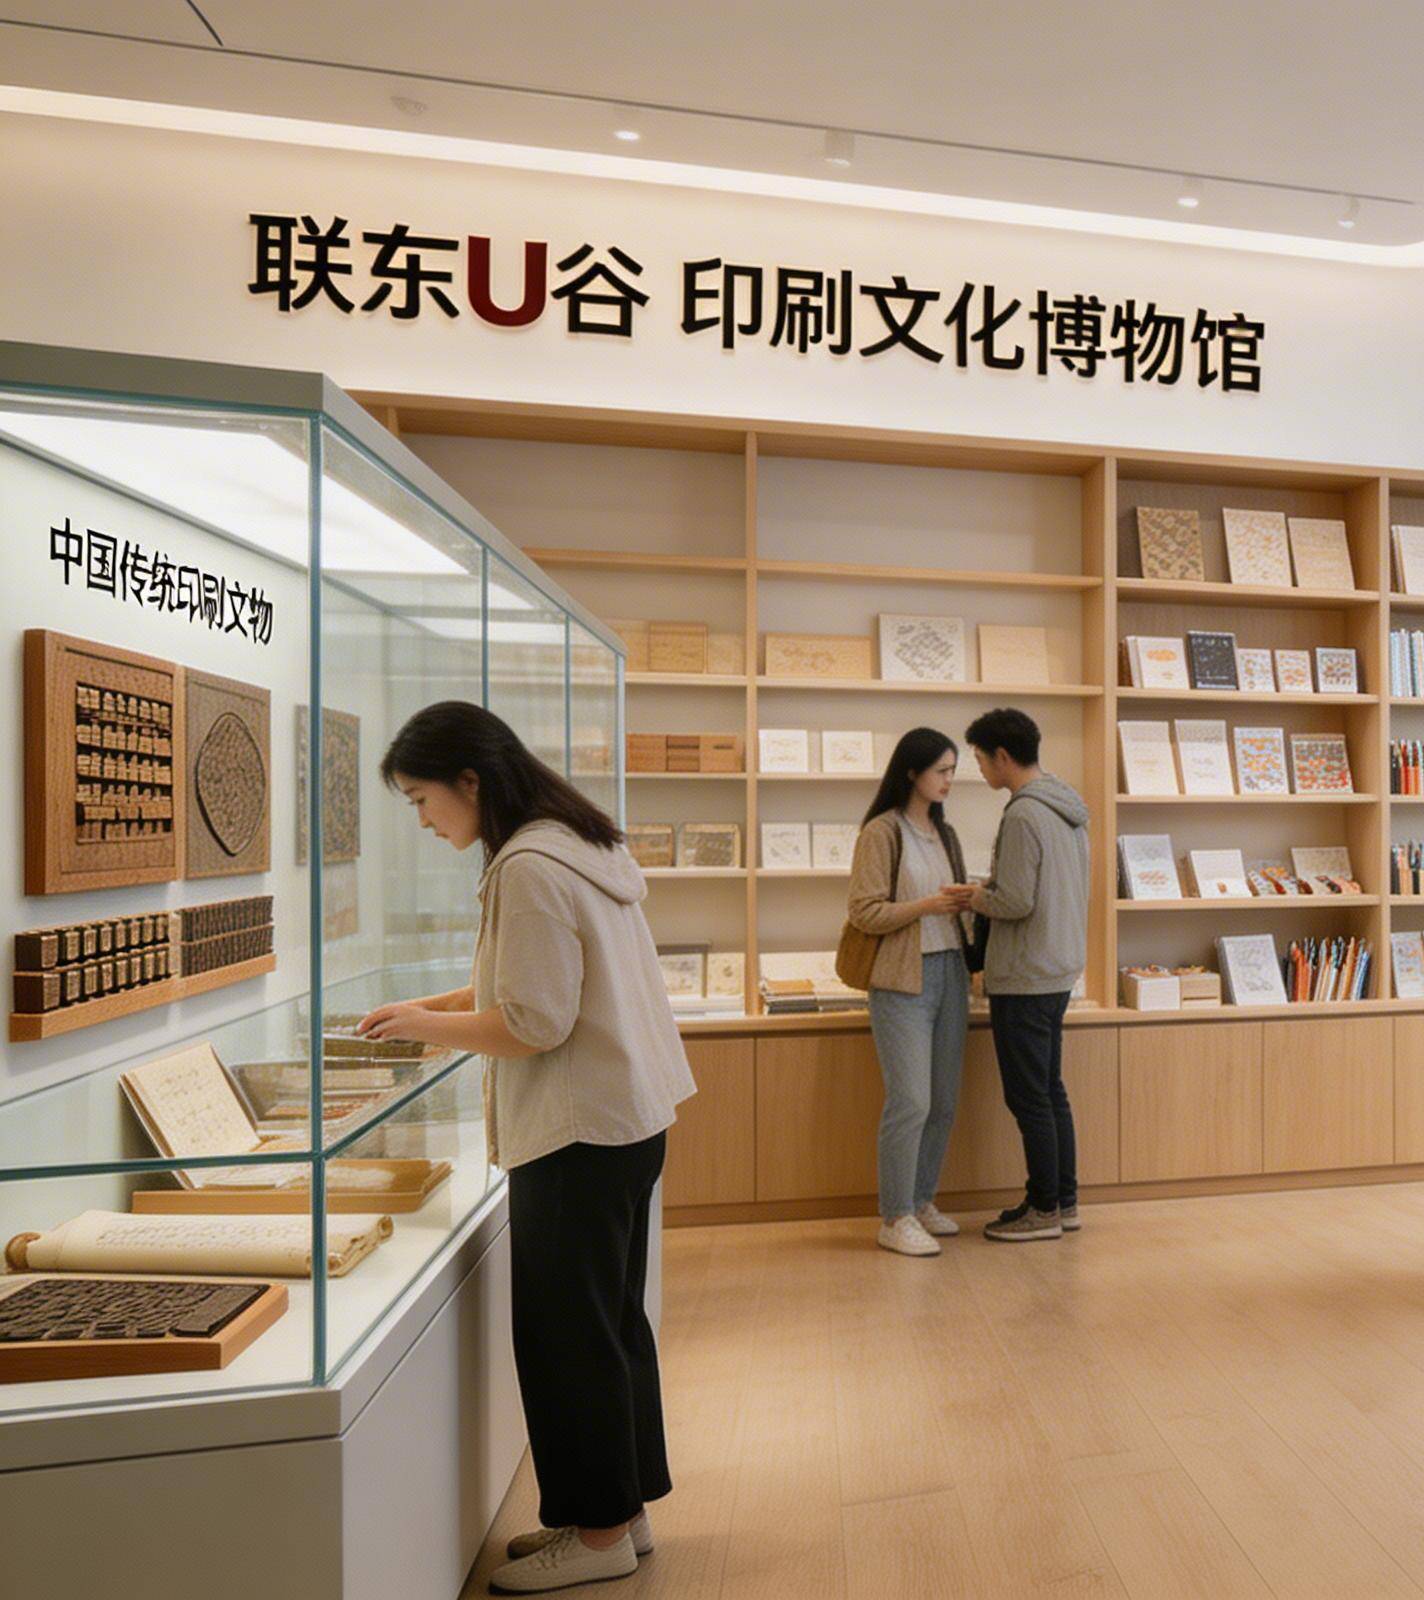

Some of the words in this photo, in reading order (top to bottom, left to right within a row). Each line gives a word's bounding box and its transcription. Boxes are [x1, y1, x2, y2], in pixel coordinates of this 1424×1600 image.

[248, 213, 650, 337] 联东U谷
[680, 257, 1265, 392] 印刷文化博物馆
[50, 517, 273, 645] 中国传统印刷文物
